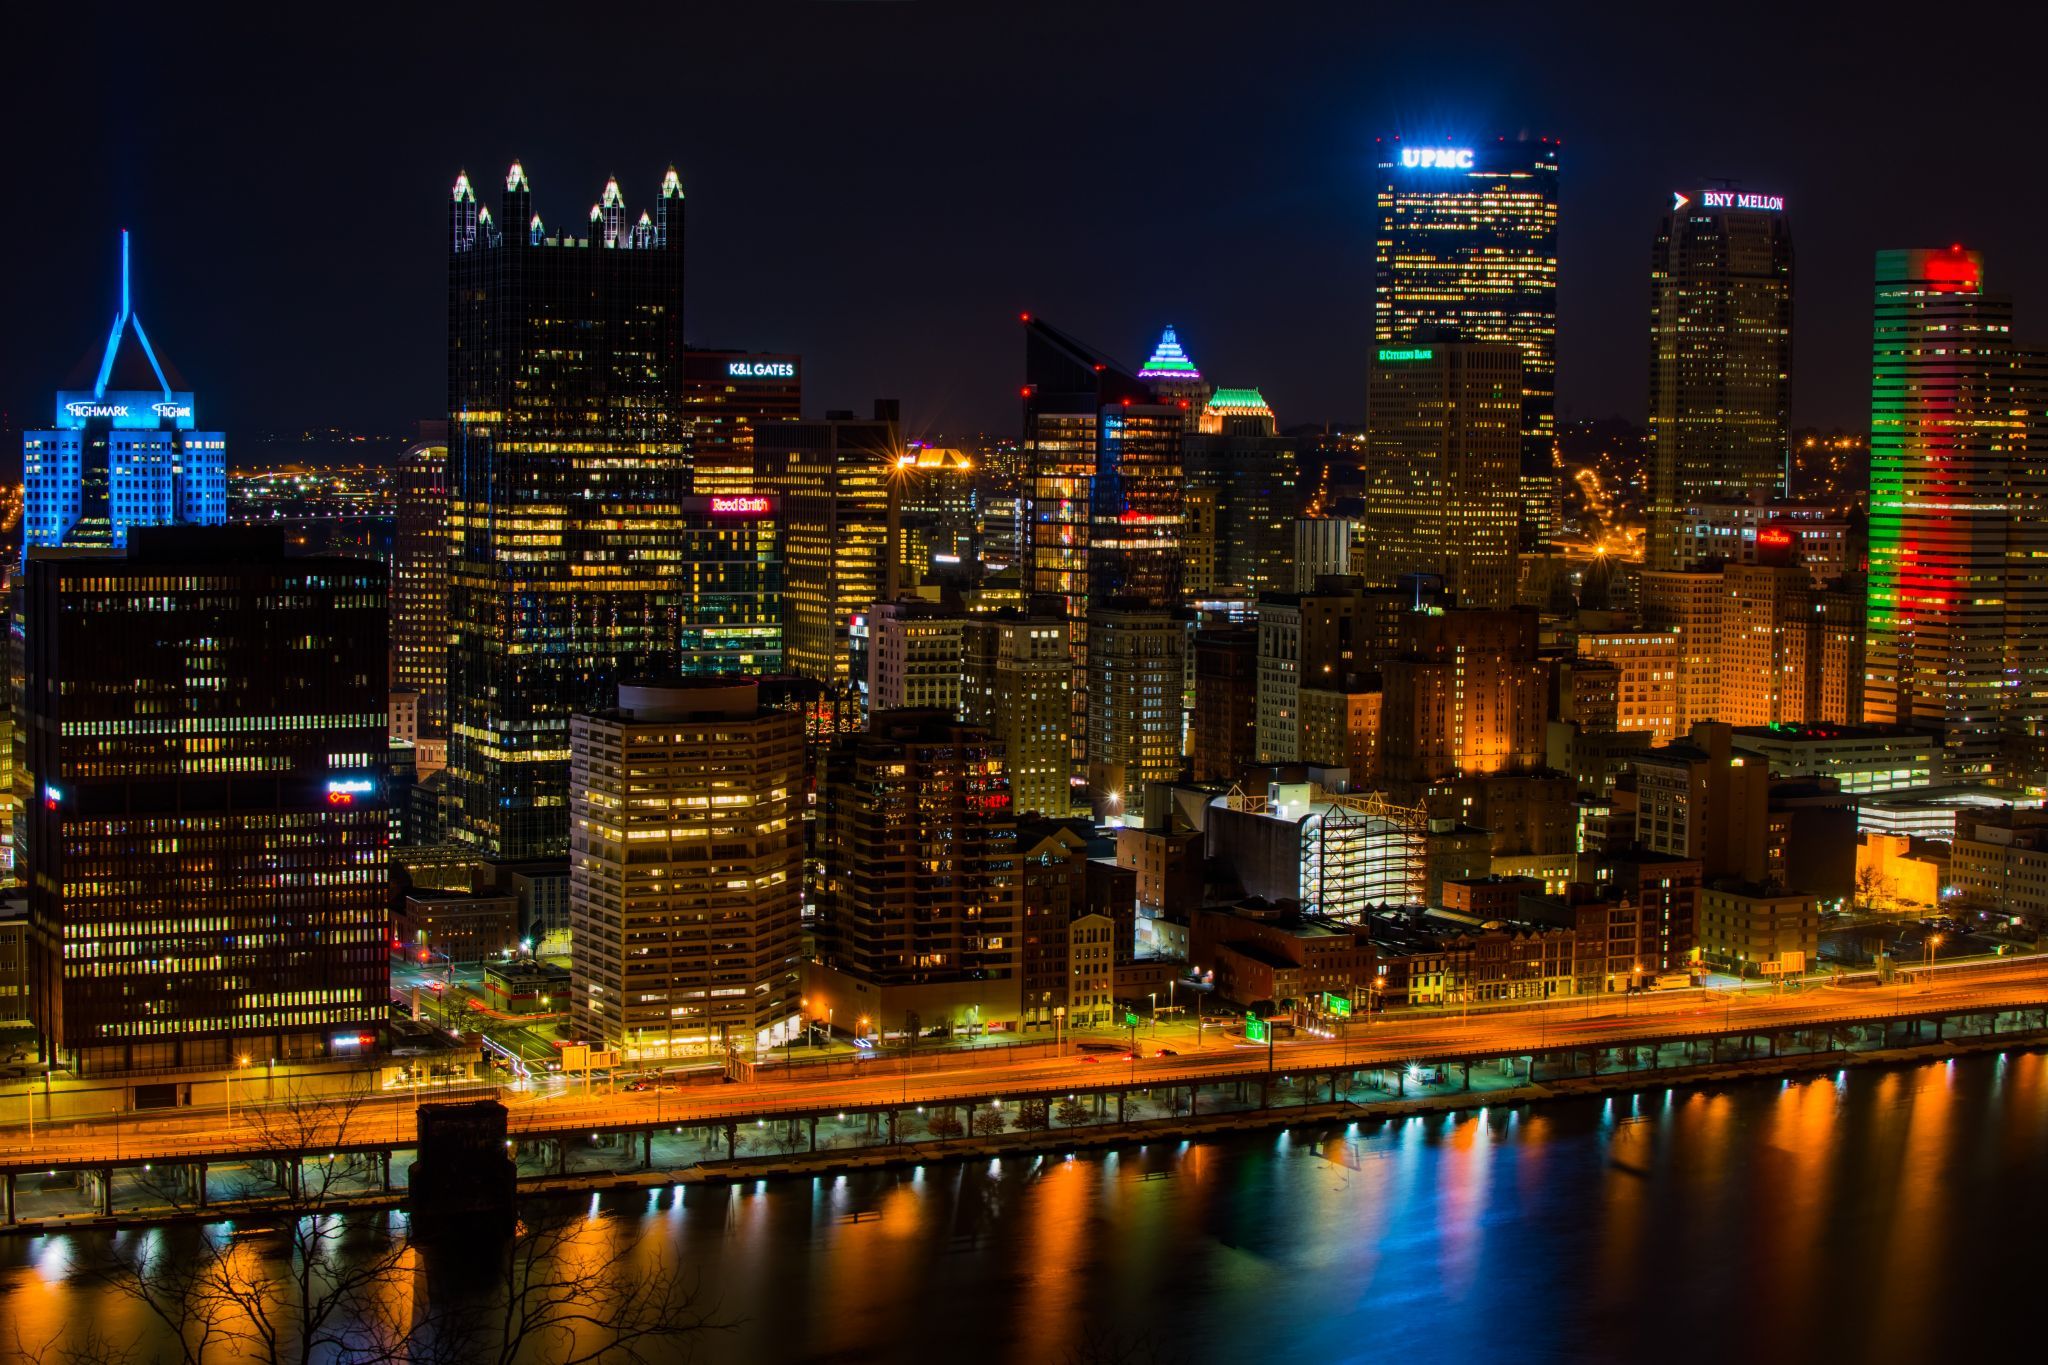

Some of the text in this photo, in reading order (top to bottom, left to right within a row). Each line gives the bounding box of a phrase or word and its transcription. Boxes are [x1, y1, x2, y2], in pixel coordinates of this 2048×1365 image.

[1402, 148, 1474, 168] UPMC
[1704, 193, 1784, 210] BNY MELLON
[729, 363, 794, 376] K&L GATES
[66, 402, 129, 417] HIGHMARK
[712, 498, 768, 511] Reed Smith
